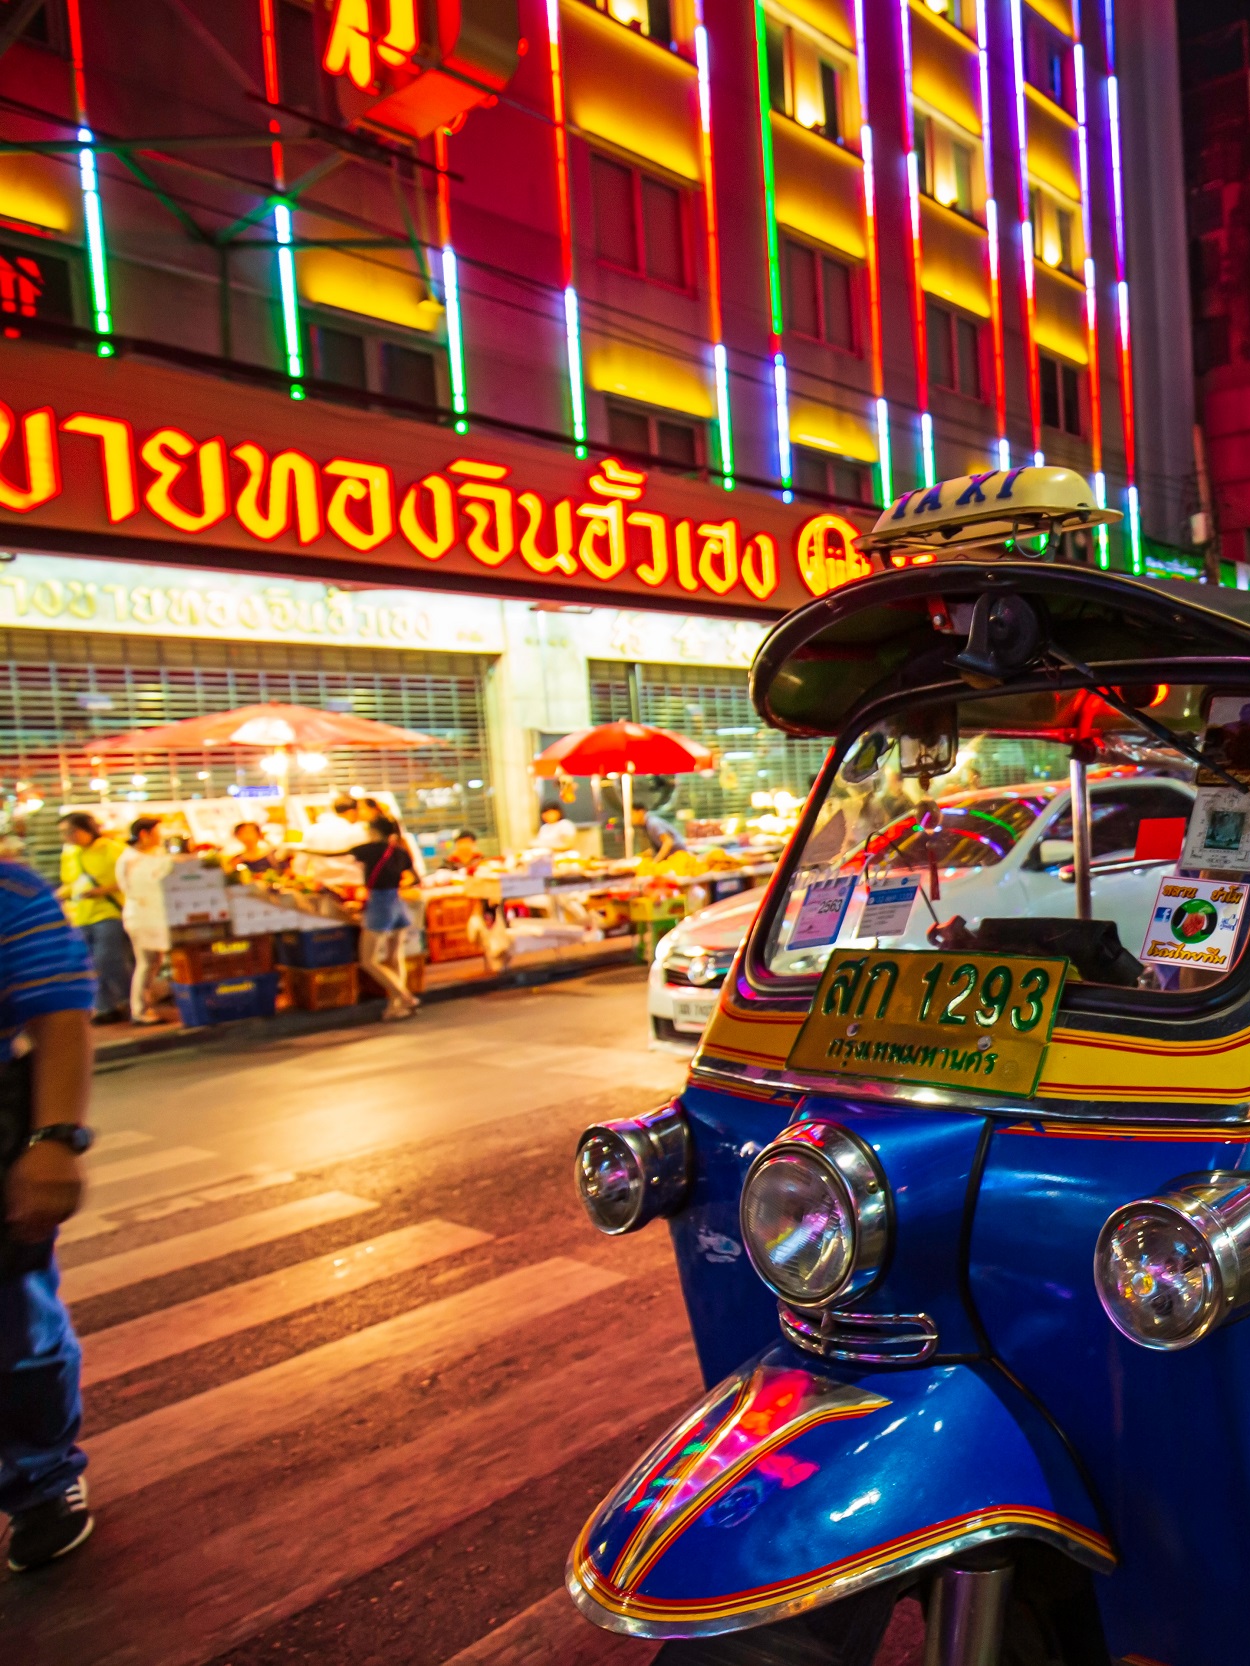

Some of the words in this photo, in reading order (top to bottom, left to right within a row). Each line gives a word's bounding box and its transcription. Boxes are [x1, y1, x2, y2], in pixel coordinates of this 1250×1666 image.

[891, 466, 1027, 519] TAXI
[817, 898, 843, 914] 2563
[820, 956, 899, 1020] สก
[917, 961, 1050, 1031] 1293
[825, 1037, 999, 1075] กรุงเทพมหานคร
